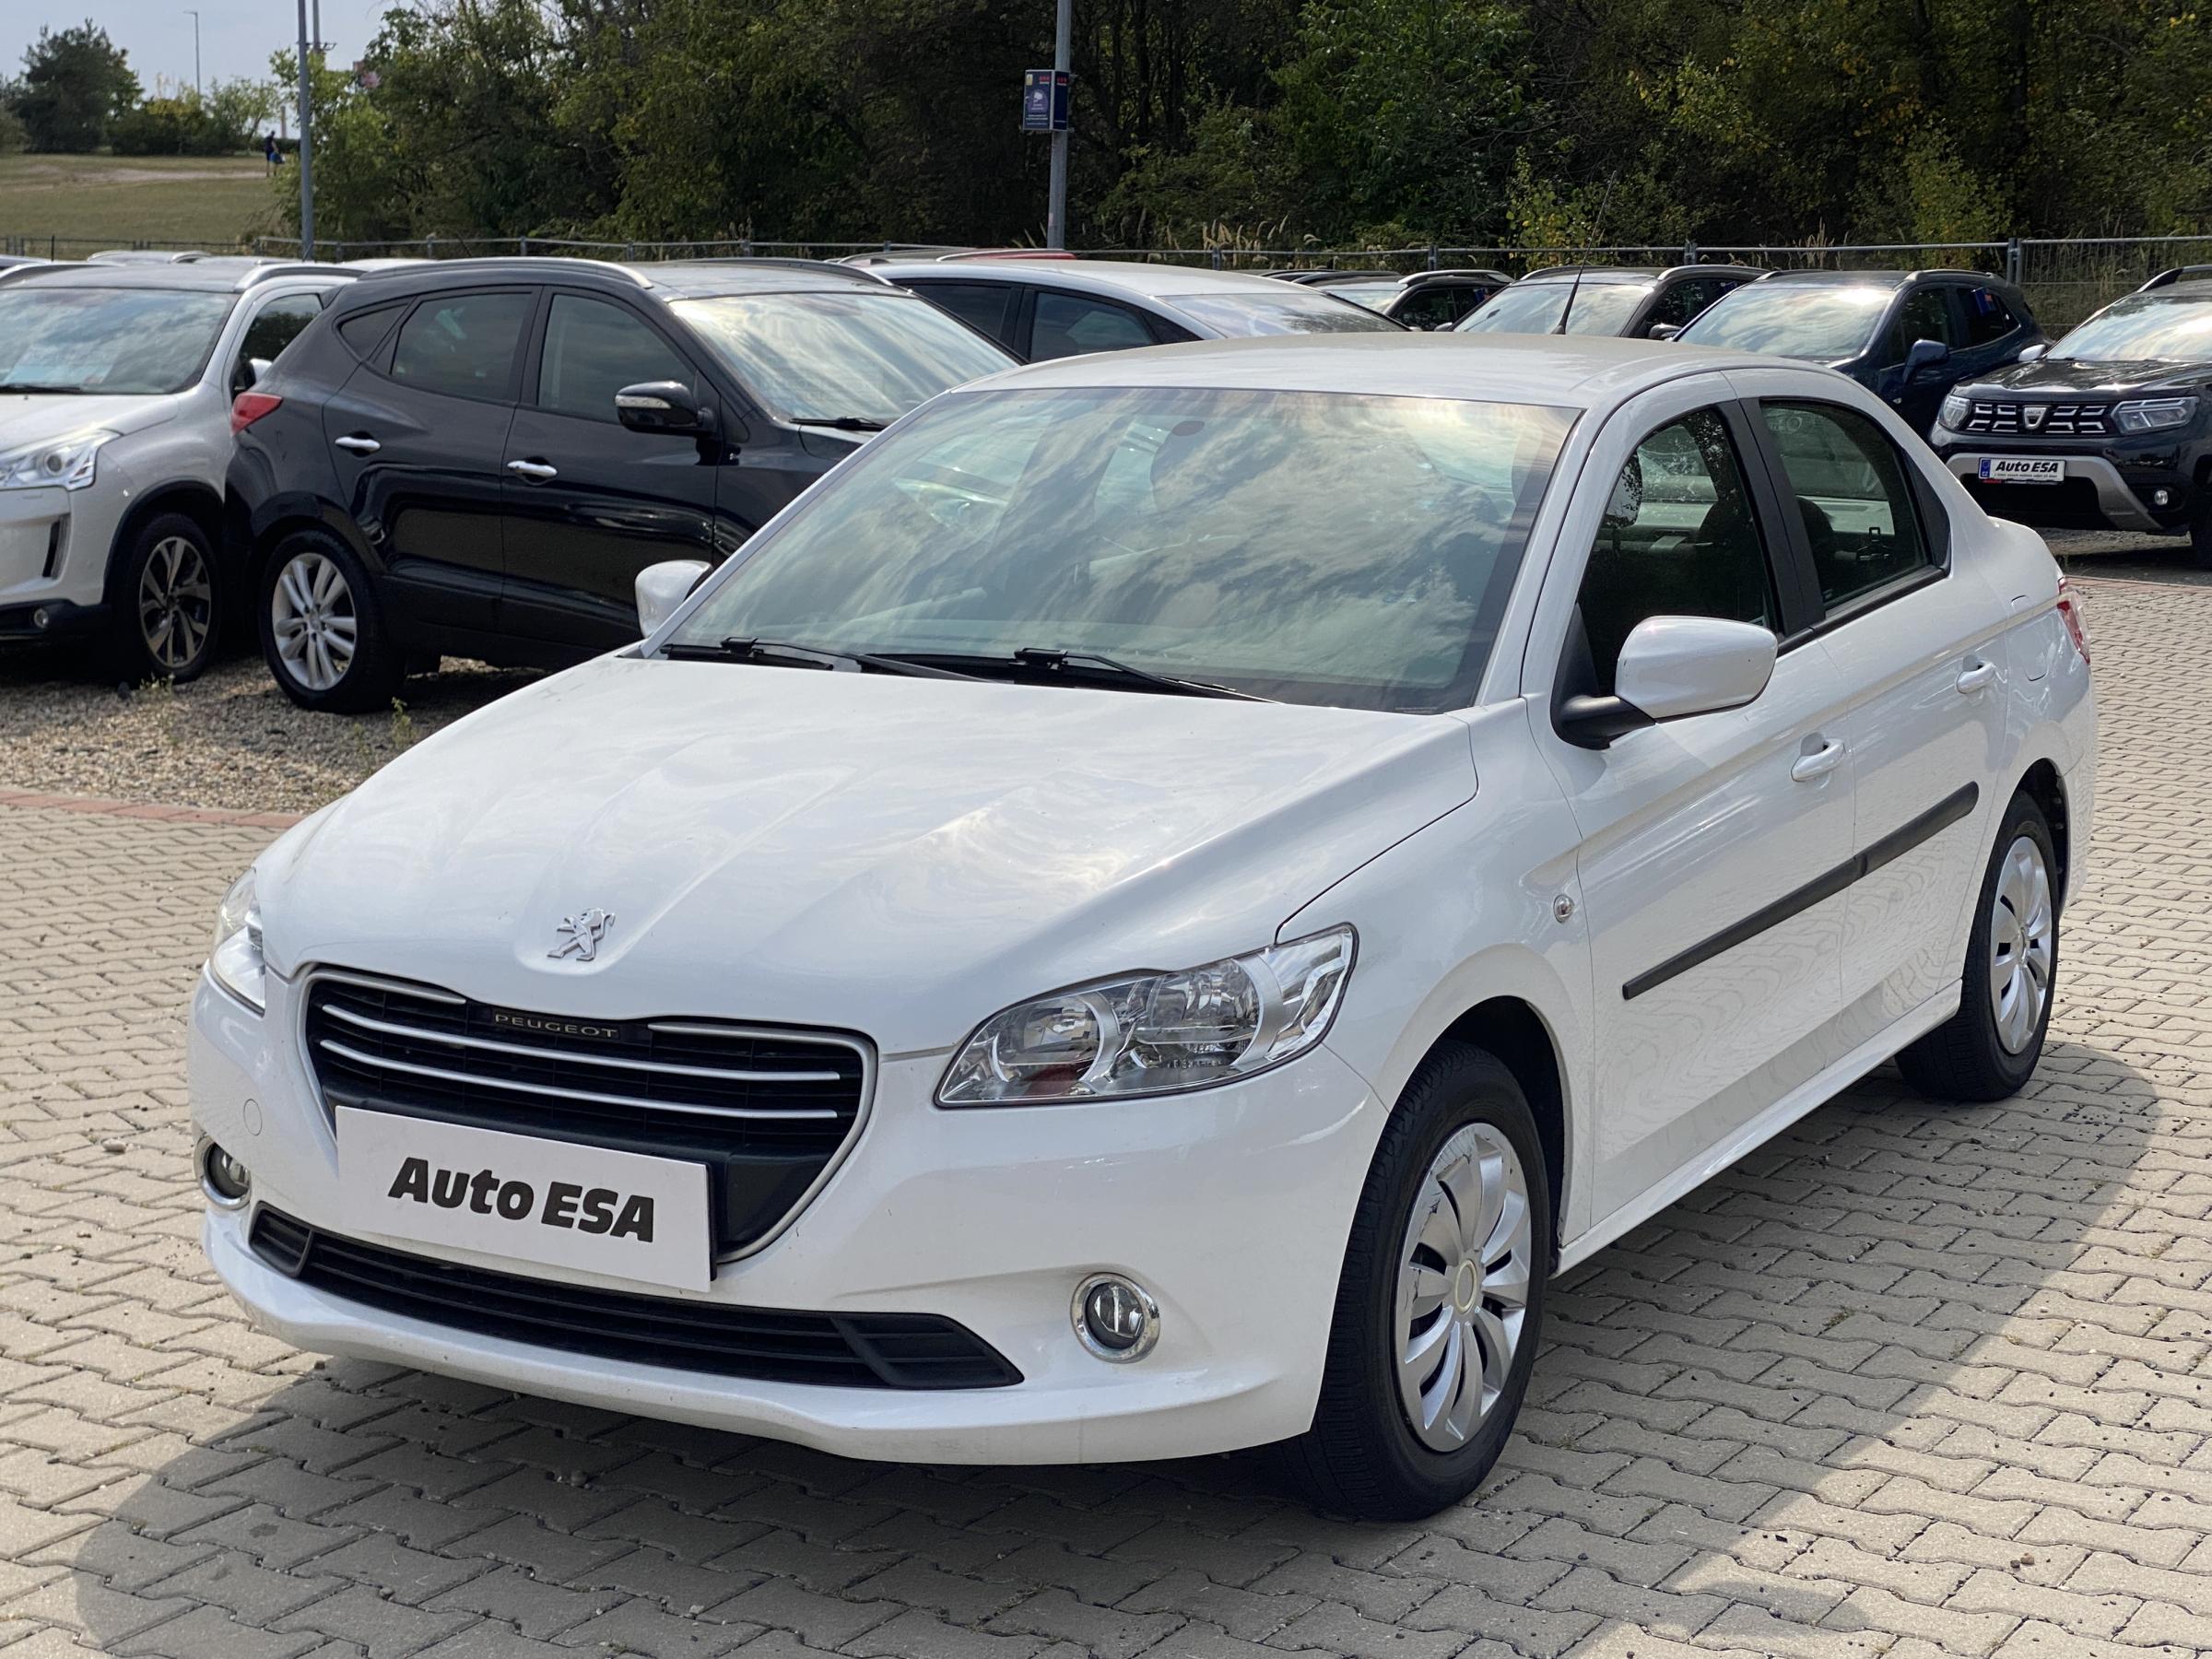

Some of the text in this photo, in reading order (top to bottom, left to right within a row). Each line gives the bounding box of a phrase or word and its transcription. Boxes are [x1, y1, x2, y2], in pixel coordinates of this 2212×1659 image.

[1995, 461, 2059, 473] Auto ESA
[495, 1014, 618, 1038] PEUGEOT
[387, 1157, 654, 1243] Auto ESA
